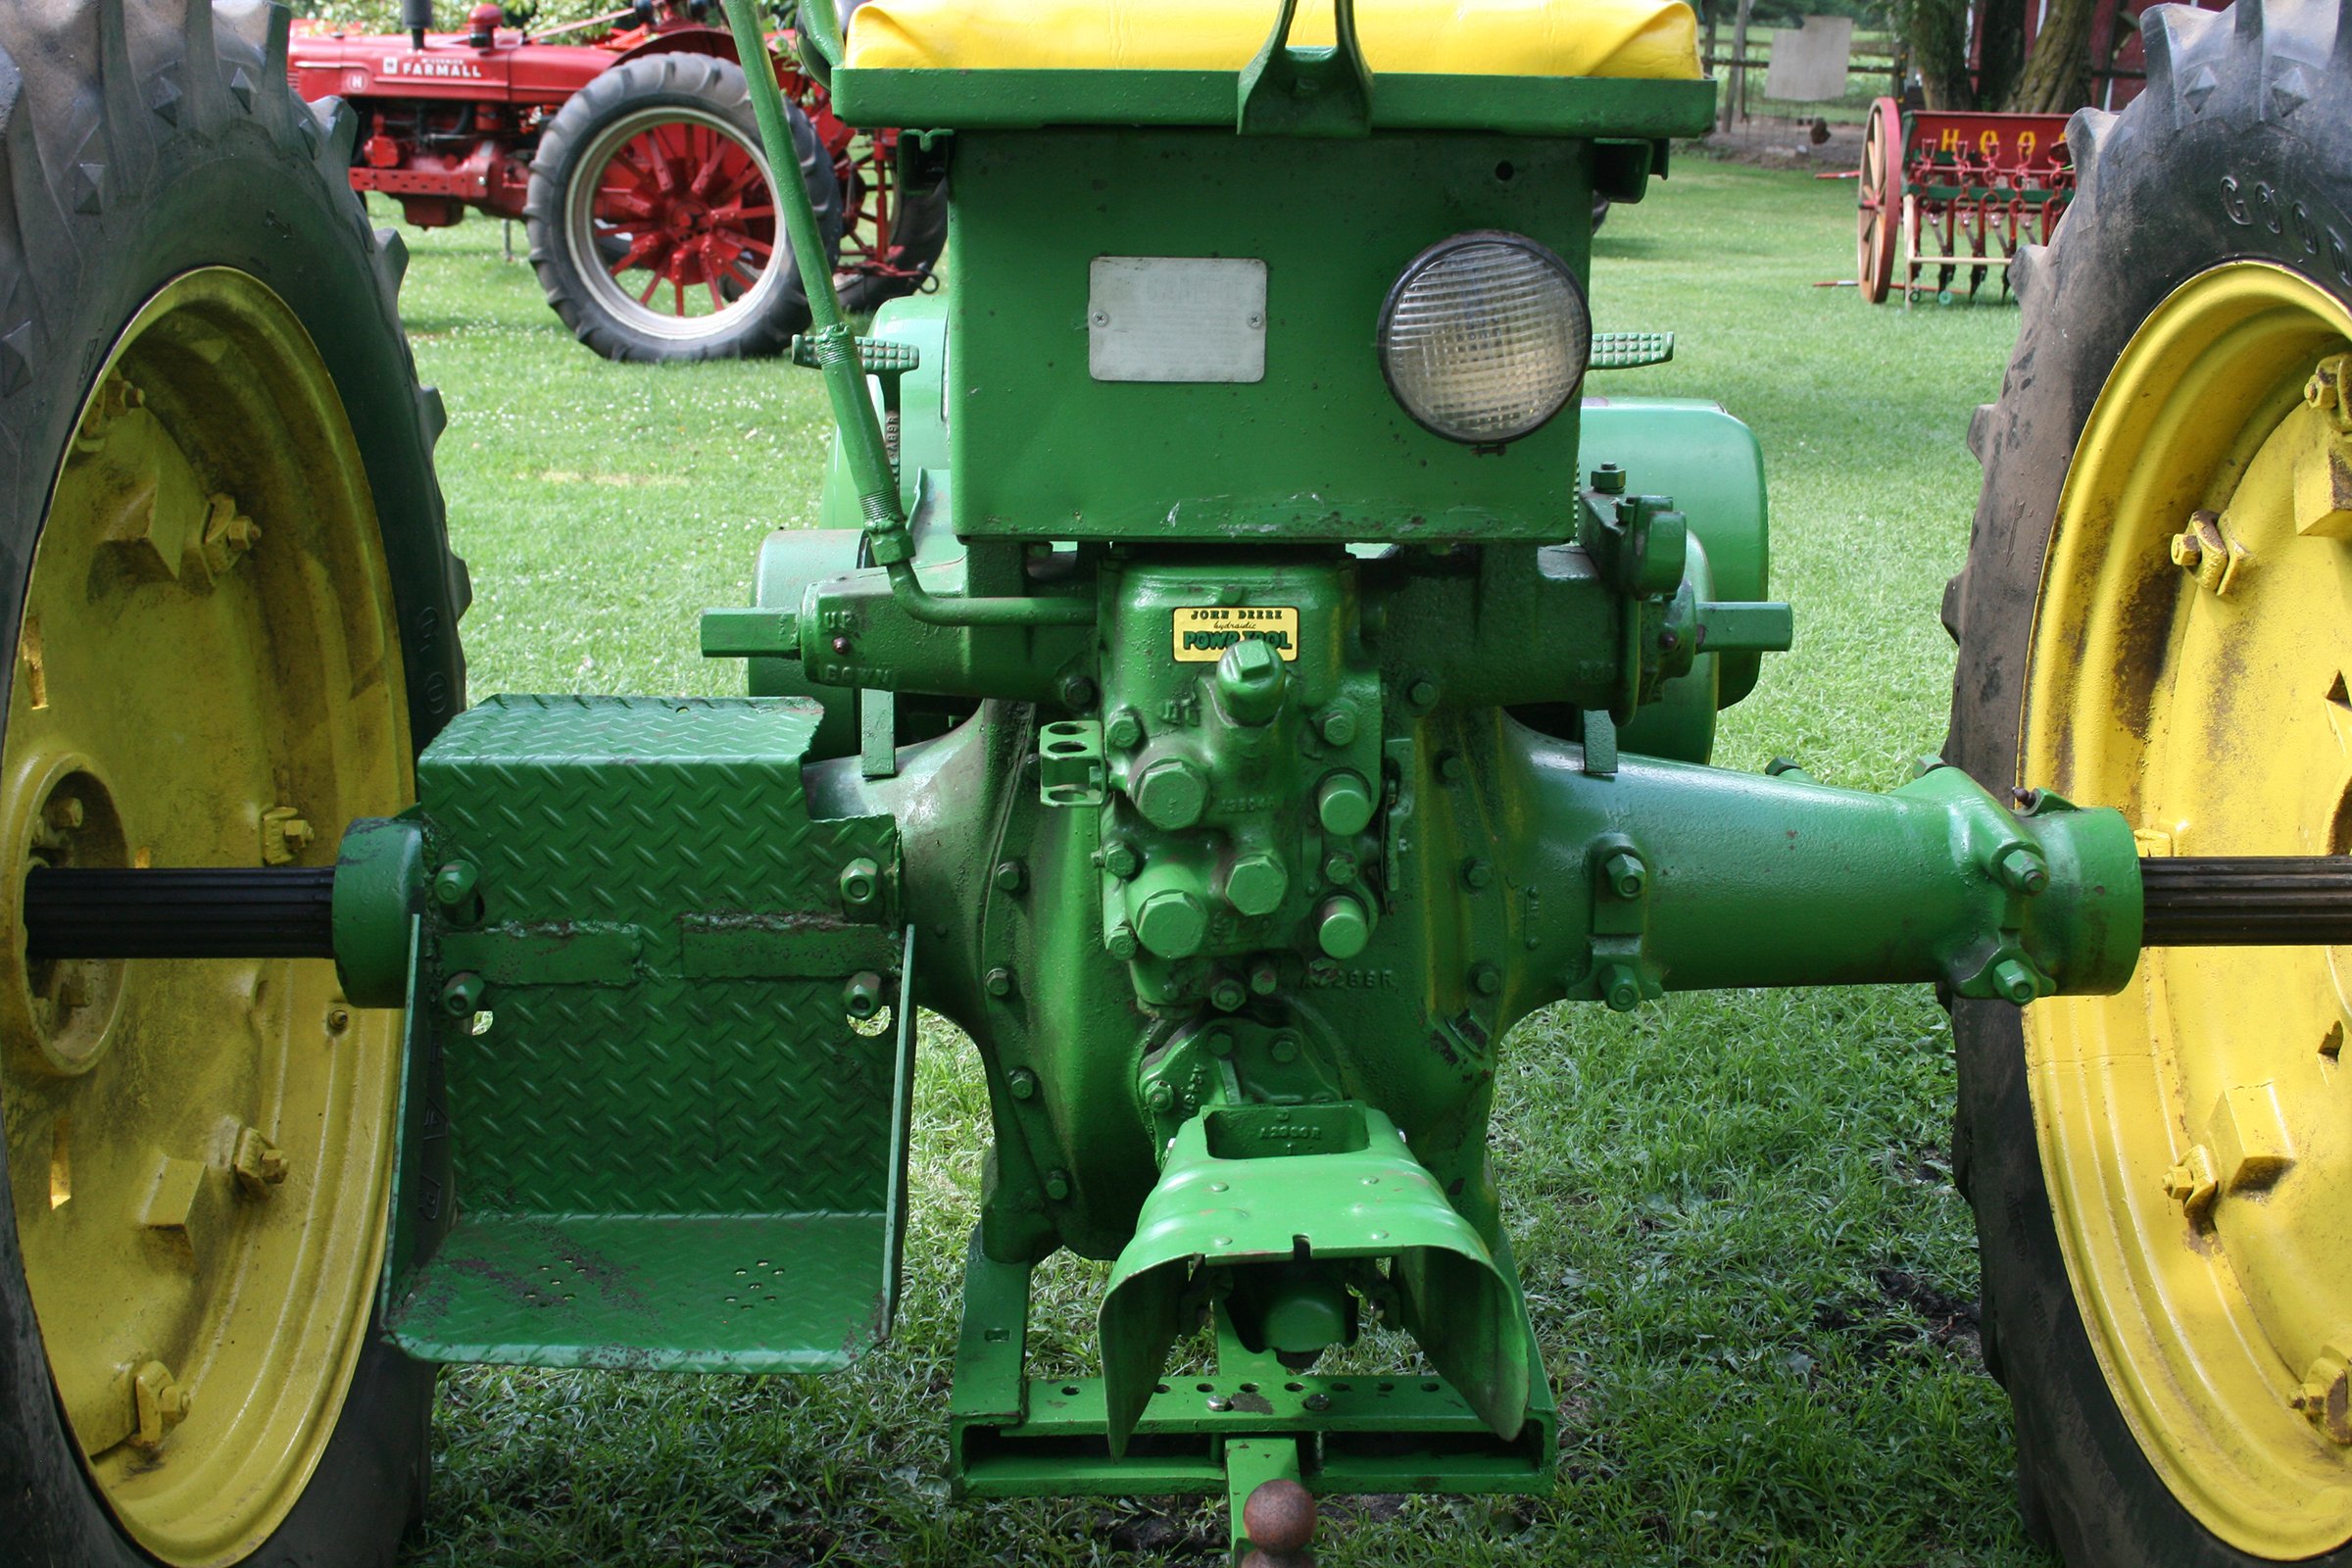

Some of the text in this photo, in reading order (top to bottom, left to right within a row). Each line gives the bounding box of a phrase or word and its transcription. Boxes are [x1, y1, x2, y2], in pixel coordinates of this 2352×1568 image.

[403, 62, 482, 78] FARMALL
[351, 74, 364, 89] H
[1940, 128, 2067, 154] HOO
[1191, 610, 1282, 620] JOHN DEERE
